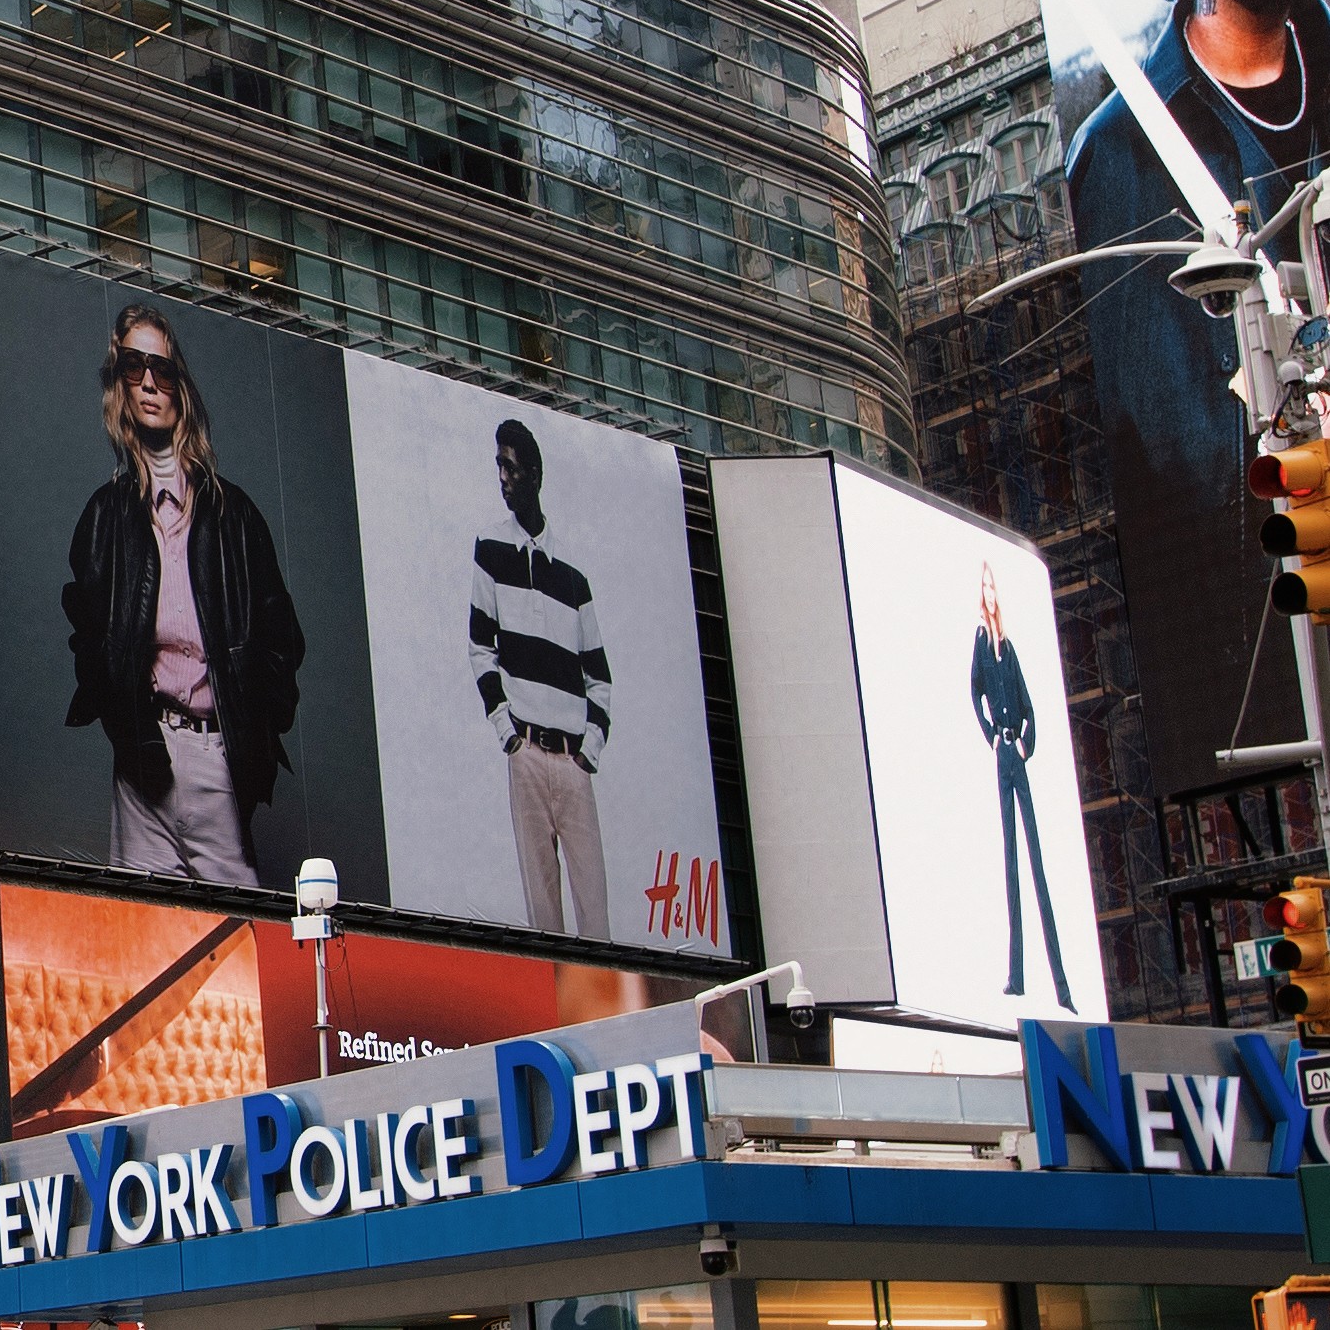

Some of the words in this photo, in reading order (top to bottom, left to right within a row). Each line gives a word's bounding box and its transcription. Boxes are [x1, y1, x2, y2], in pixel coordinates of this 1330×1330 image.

[644, 849, 720, 948] H&M
[337, 1031, 417, 1064] Refined
[1020, 1018, 1240, 1175] NEW
[67, 1125, 241, 1253] YORK
[242, 1092, 478, 1227] POLICE
[494, 1038, 713, 1186] DEPT
